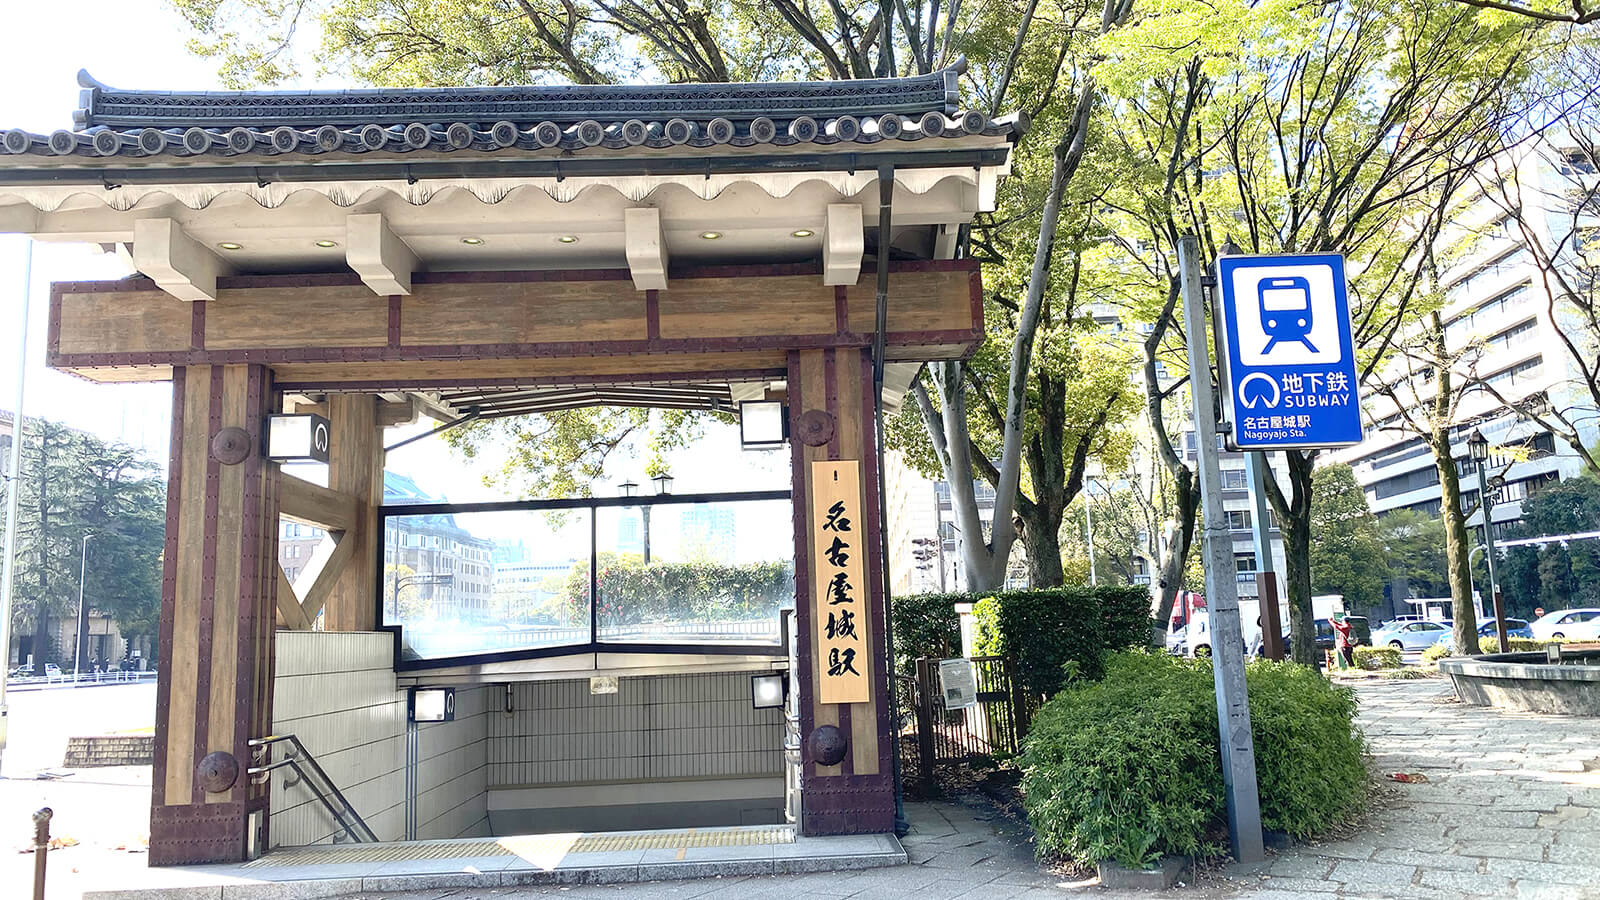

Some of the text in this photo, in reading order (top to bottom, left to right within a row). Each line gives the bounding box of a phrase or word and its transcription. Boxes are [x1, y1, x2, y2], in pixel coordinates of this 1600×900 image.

[1281, 371, 1349, 394] 地下鉄
[1284, 393, 1350, 408] SUBWAY
[1243, 414, 1312, 430] 名古屋城駅
[1244, 429, 1307, 441] Nagoyajo Sta.
[822, 500, 861, 678] 名古屋城駅
